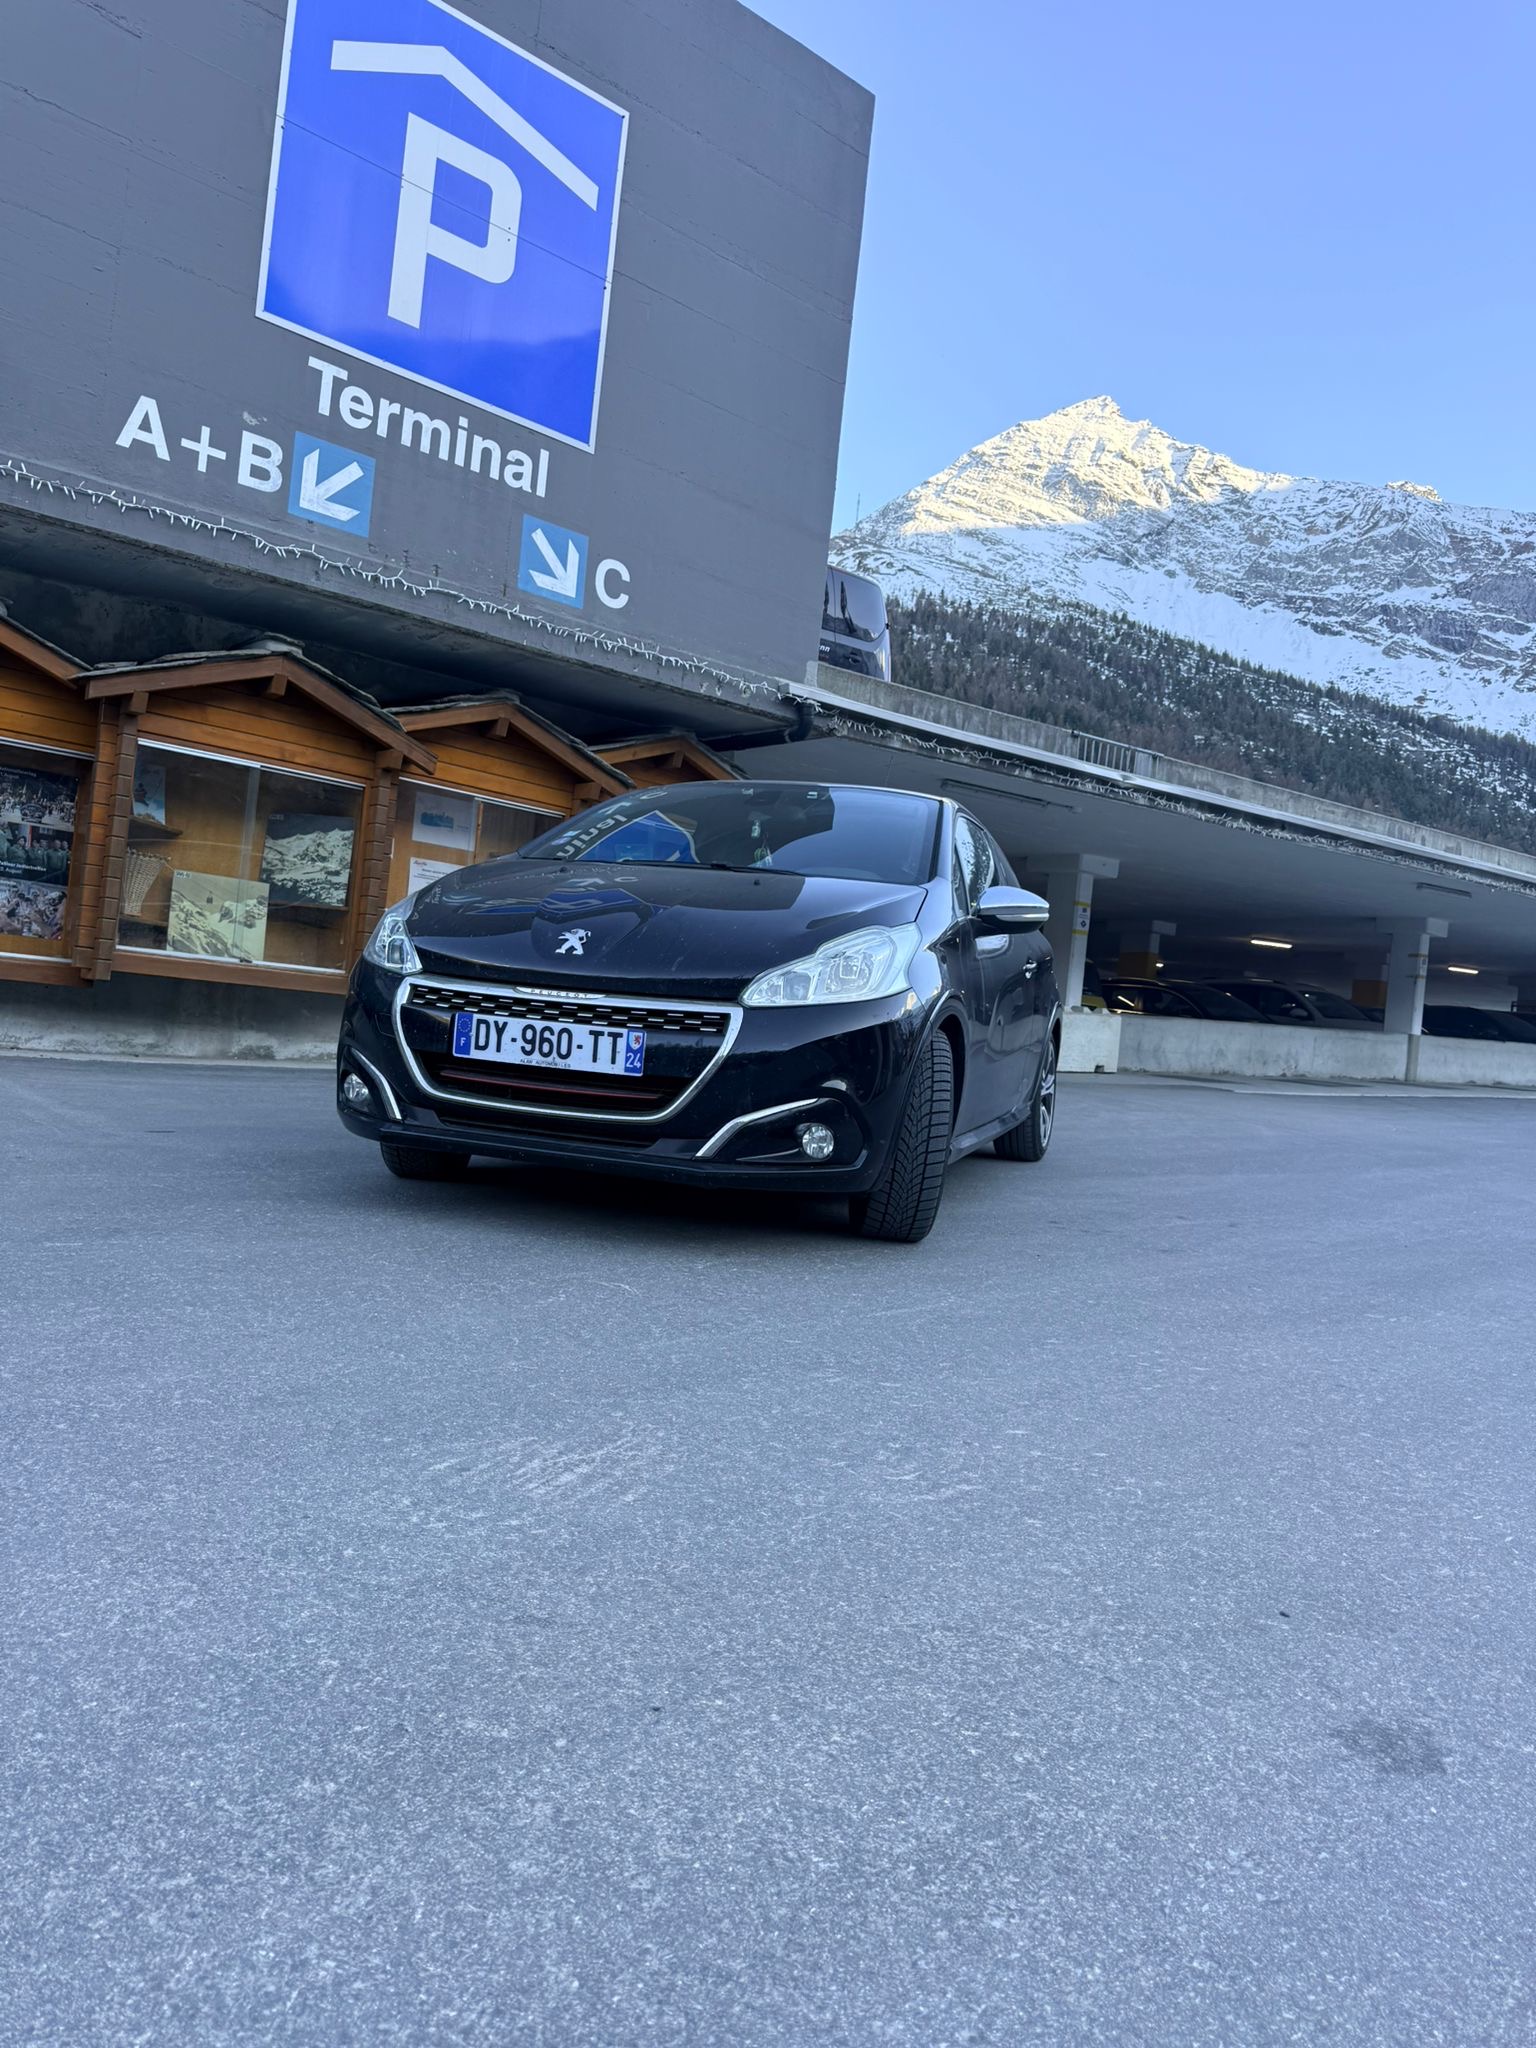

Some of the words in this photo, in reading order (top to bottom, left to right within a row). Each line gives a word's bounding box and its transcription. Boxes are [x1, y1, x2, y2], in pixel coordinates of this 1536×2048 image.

[388, 113, 522, 328] P
[308, 356, 550, 498] Terminal
[595, 559, 631, 609] C
[460, 1037, 467, 1047] F
[474, 1018, 624, 1065] DY-960-TT
[626, 1052, 642, 1069] 24
